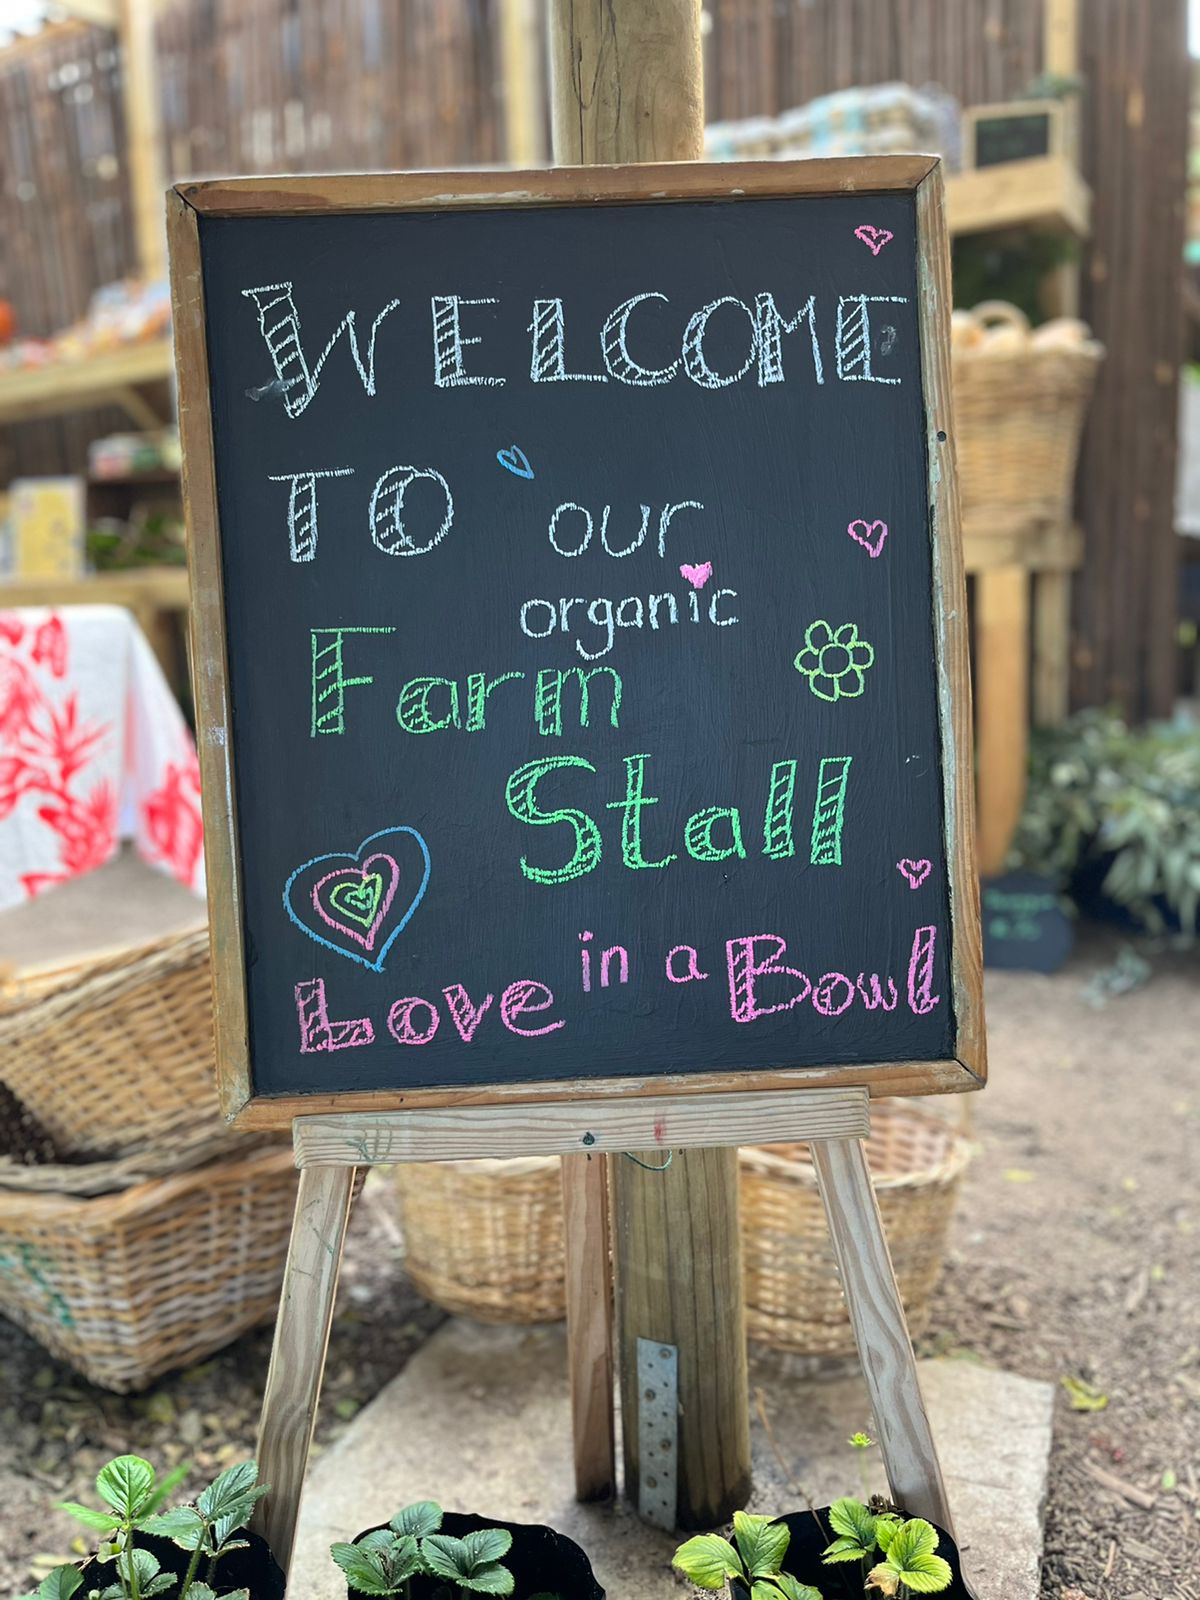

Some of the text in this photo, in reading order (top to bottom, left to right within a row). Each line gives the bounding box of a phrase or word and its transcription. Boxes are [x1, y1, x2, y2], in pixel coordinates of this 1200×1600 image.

[241, 281, 909, 419] WELCOME
[268, 465, 705, 563] TO our
[520, 562, 739, 661] organic
[309, 626, 624, 738] Farm
[504, 753, 853, 886] Stall
[294, 924, 941, 1054] Love in a Bowl
